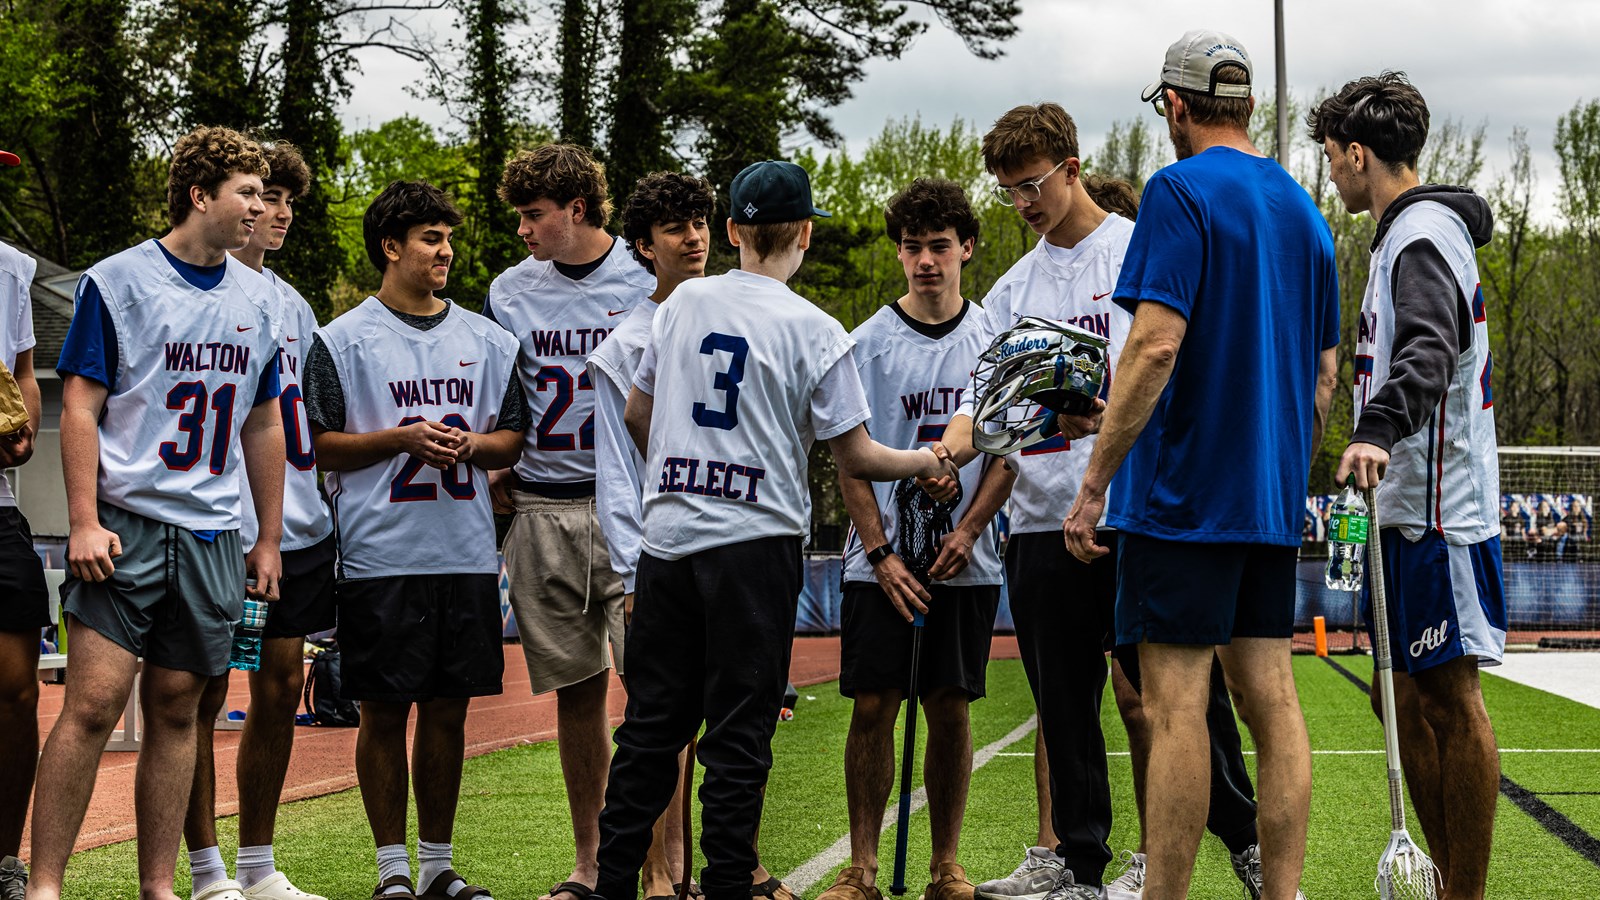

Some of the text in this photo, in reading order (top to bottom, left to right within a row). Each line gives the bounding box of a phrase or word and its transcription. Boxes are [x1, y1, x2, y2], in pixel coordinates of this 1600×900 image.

[165, 342, 249, 375] WALTON
[531, 327, 614, 358] WALTO
[1000, 336, 1050, 361] Raiders
[388, 377, 474, 408] WALTON
[692, 332, 749, 431] 3
[158, 380, 236, 476] 31
[658, 456, 767, 502] SELECT
[1409, 619, 1448, 658] Atl
